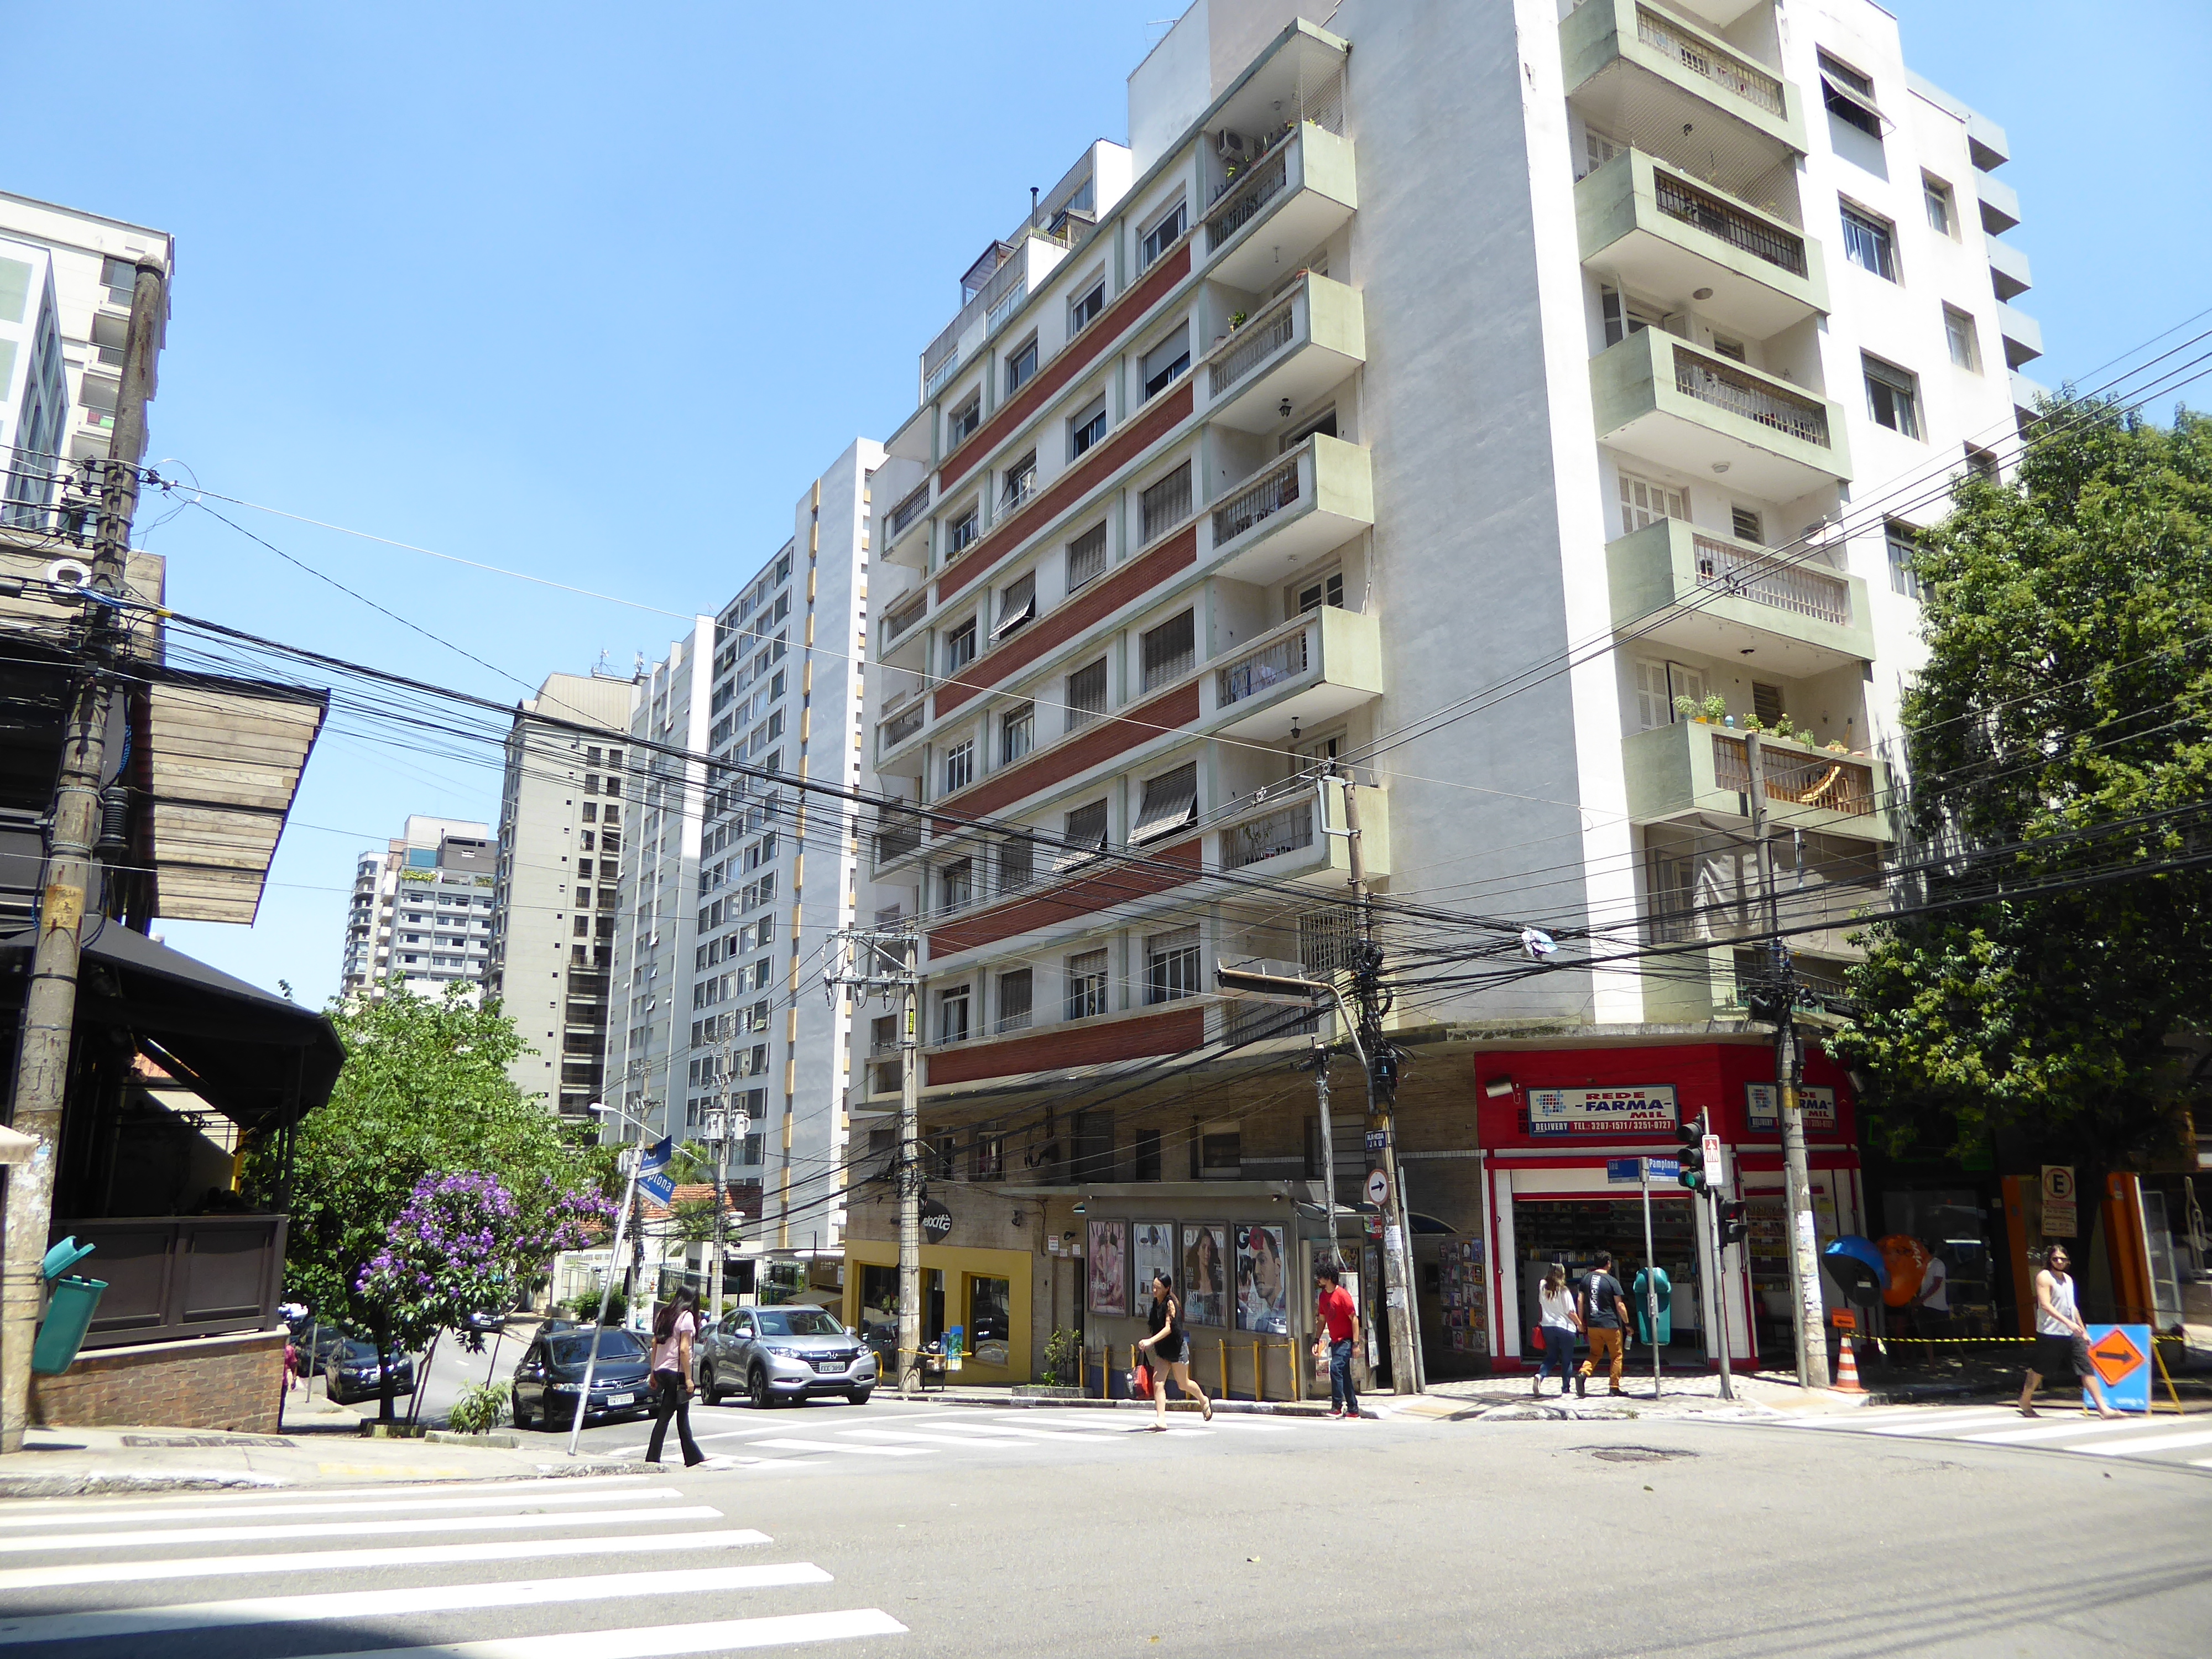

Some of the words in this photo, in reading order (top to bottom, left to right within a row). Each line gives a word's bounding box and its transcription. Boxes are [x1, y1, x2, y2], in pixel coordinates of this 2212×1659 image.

[1585, 1092, 1645, 1100] REDE
[1535, 1122, 1568, 1131] DELIVERY
[1634, 1121, 1671, 1130] 3251-0727
[1649, 1158, 1678, 1171] Pamplona
[647, 1173, 672, 1192] plona
[2053, 1174, 2064, 1193] E
[1091, 1222, 1125, 1240] VOUE
[1184, 1229, 1224, 1248] GLAUR
